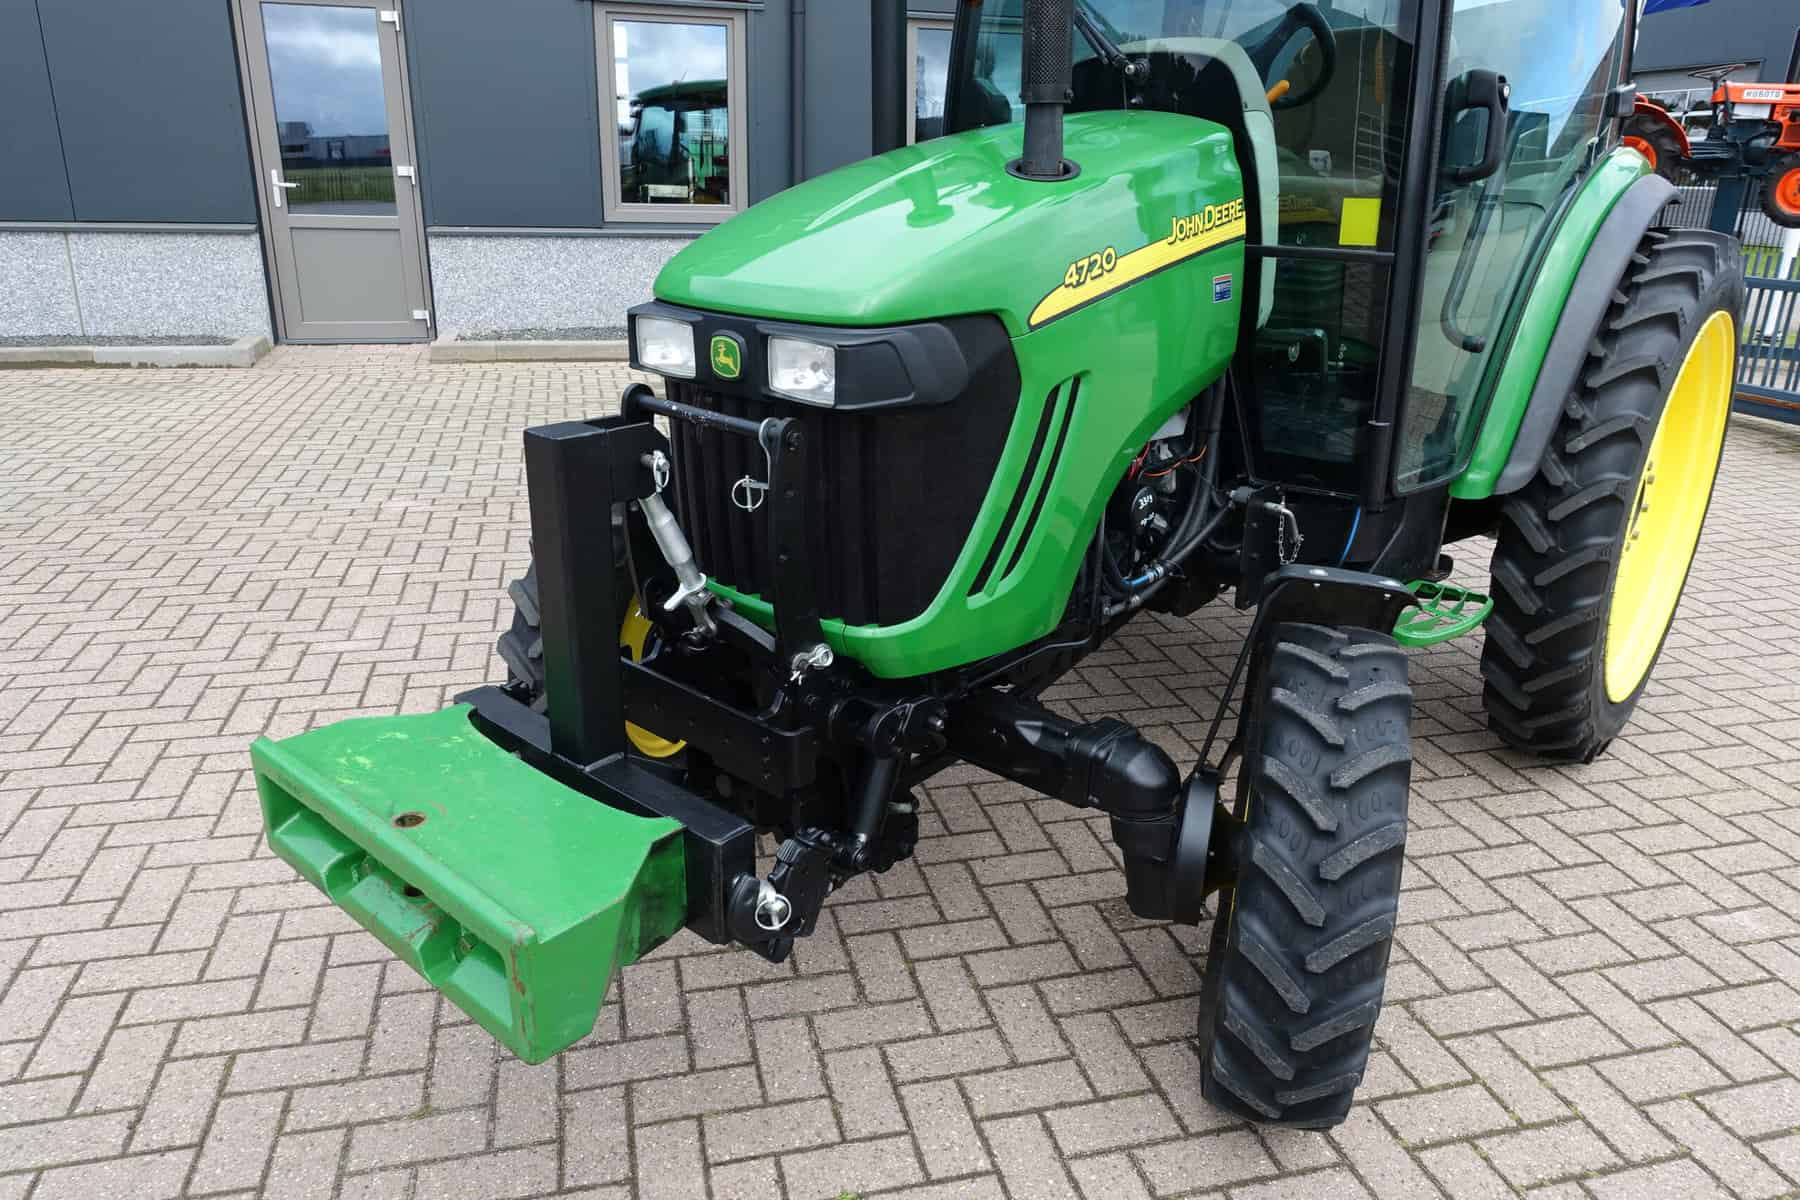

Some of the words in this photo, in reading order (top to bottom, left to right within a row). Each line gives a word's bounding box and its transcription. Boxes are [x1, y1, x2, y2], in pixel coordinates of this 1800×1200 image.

[1167, 212, 1204, 245] JOHN
[1203, 197, 1243, 231] DEERE
[1064, 247, 1117, 288] 4720
